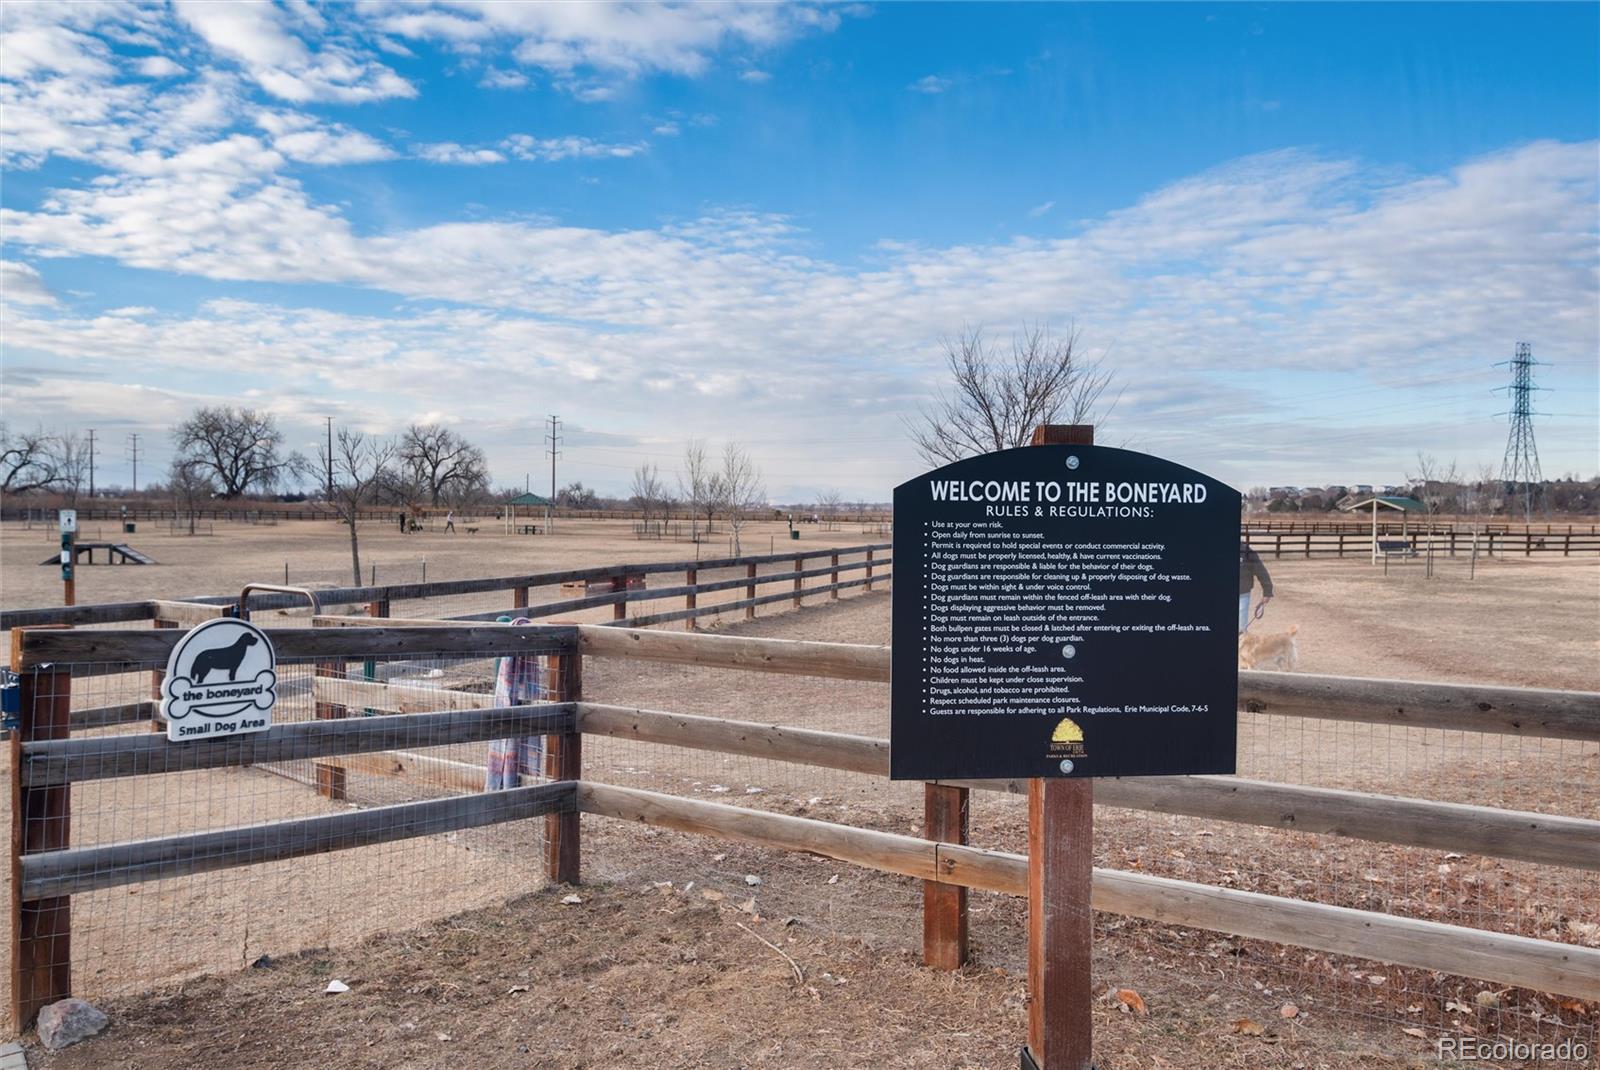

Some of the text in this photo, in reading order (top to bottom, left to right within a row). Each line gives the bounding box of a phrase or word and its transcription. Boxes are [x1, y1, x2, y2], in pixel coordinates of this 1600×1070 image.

[931, 480, 1206, 503] WELCOME TO THE BONEYARD
[987, 506, 1153, 517] RULES & REGULATIONS:
[931, 520, 945, 528] Use
[955, 522, 971, 530] your
[989, 520, 1003, 528] risk.
[931, 530, 951, 541] Open
[952, 530, 968, 541] daily
[969, 530, 986, 538] from
[931, 540, 954, 549] Permit
[962, 540, 991, 551] required
[1002, 541, 1017, 549] hold
[1018, 541, 1041, 551] special
[1074, 541, 1102, 550] conduct
[1102, 541, 1140, 550] commercial
[1141, 542, 1166, 552] activity.
[931, 551, 941, 559] All
[942, 551, 959, 561] dogs
[978, 551, 987, 559] be
[988, 551, 1017, 562] properly
[1018, 551, 1047, 560] licensed,
[1047, 551, 1072, 562] healthy,
[1072, 551, 1078, 560] &
[1079, 551, 1095, 560] have
[931, 561, 946, 572] Dog
[947, 561, 979, 572] guardians
[992, 561, 1030, 572] responsible
[1031, 562, 1038, 570] &
[1039, 562, 1056, 570] liable
[1057, 562, 1068, 570] for
[1069, 562, 1081, 570] the
[1082, 562, 1111, 570] behavior
[1111, 562, 1120, 570] of
[1120, 562, 1136, 570] their
[1137, 562, 1154, 572] dogs.
[930, 603, 949, 613] Dogs
[950, 603, 982, 613] displaying
[983, 603, 1016, 613] aggressive
[1017, 603, 1046, 611] behavior
[1065, 603, 1074, 611] be
[1075, 603, 1106, 611] removed.
[930, 613, 949, 624] Dogs
[1003, 613, 1021, 621] leash
[1021, 613, 1047, 621] outside
[1047, 613, 1056, 621] of
[1056, 613, 1068, 621] the
[930, 624, 947, 632] Both
[948, 624, 973, 634] bullpen
[974, 624, 992, 634] gates
[1011, 623, 1020, 632] be
[1021, 623, 1043, 632] closed
[1044, 623, 1050, 632] &
[1051, 623, 1076, 632] latched
[1076, 623, 1092, 632] after
[1093, 624, 1121, 634] entering
[1131, 624, 1154, 634] exiting
[1154, 623, 1166, 631] the
[1166, 623, 1194, 631] off-leash
[930, 634, 942, 642] No
[963, 634, 979, 642] than
[979, 634, 998, 642] three
[999, 634, 1010, 644] (3)
[1010, 634, 1027, 644] dogs
[1028, 636, 1040, 644] per
[1041, 634, 1054, 644] dog
[1054, 634, 1085, 644] guardian.
[930, 644, 1037, 655] No dogs under 16 weeks of age.
[930, 655, 942, 663] No
[943, 655, 959, 665] dogs
[968, 654, 985, 663] heat.
[930, 665, 942, 673] No
[943, 665, 959, 673] food
[960, 665, 986, 673] allowed
[987, 665, 1007, 673] inside
[1008, 665, 1020, 673] the
[1020, 664, 1049, 673] off-leash
[930, 675, 960, 684] Children
[978, 675, 988, 684] be
[989, 675, 1004, 686] kept
[1005, 675, 1026, 683] under
[1026, 675, 1044, 683] close
[1045, 675, 1084, 685] supervision.
[182, 684, 263, 700] the boneyard
[930, 686, 952, 696] Drugs,
[953, 686, 979, 695] alcohol,
[979, 686, 992, 694] and
[993, 685, 1021, 694] tobacco
[1034, 685, 1070, 696] prohibited.
[930, 696, 957, 707] Respect
[958, 696, 992, 704] scheduled
[992, 696, 1008, 706] park
[1051, 695, 1081, 704] closures.
[929, 706, 954, 715] Guests
[967, 706, 1005, 717] responsible
[1006, 706, 1017, 714] for
[1018, 706, 1047, 716] adhering
[1057, 706, 1065, 714] all
[1066, 706, 1082, 714] Park
[1082, 705, 1122, 716] Regulations,
[1124, 705, 1138, 713] Erie
[1139, 705, 1170, 715] Municipal
[1170, 704, 1191, 714] Code,
[1191, 704, 1209, 713] 7-6-5
[179, 719, 265, 736] Small Dog Area
